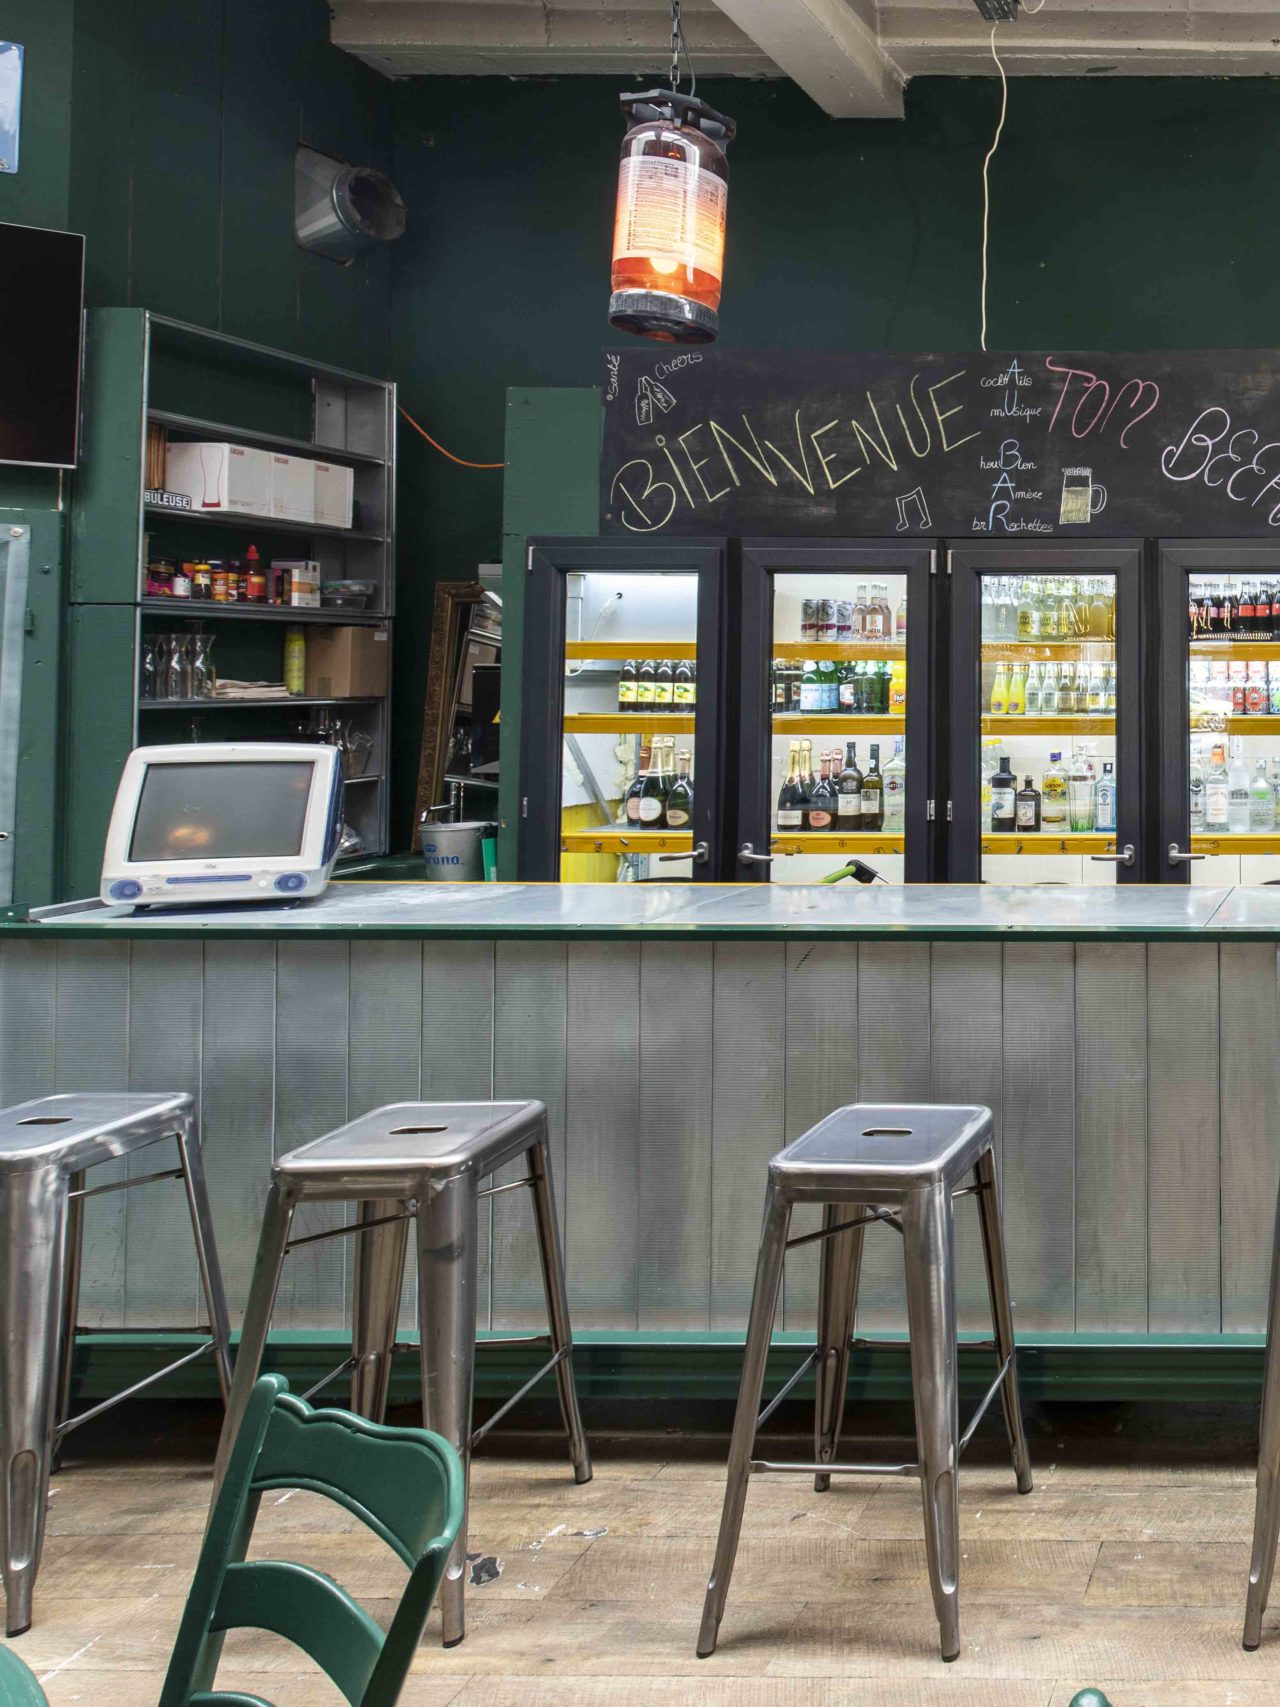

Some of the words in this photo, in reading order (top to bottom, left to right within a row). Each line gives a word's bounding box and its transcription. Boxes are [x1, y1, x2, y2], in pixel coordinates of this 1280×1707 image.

[606, 353, 620, 397] Santé
[655, 351, 703, 379] Cheers
[1046, 356, 1160, 448] TOM
